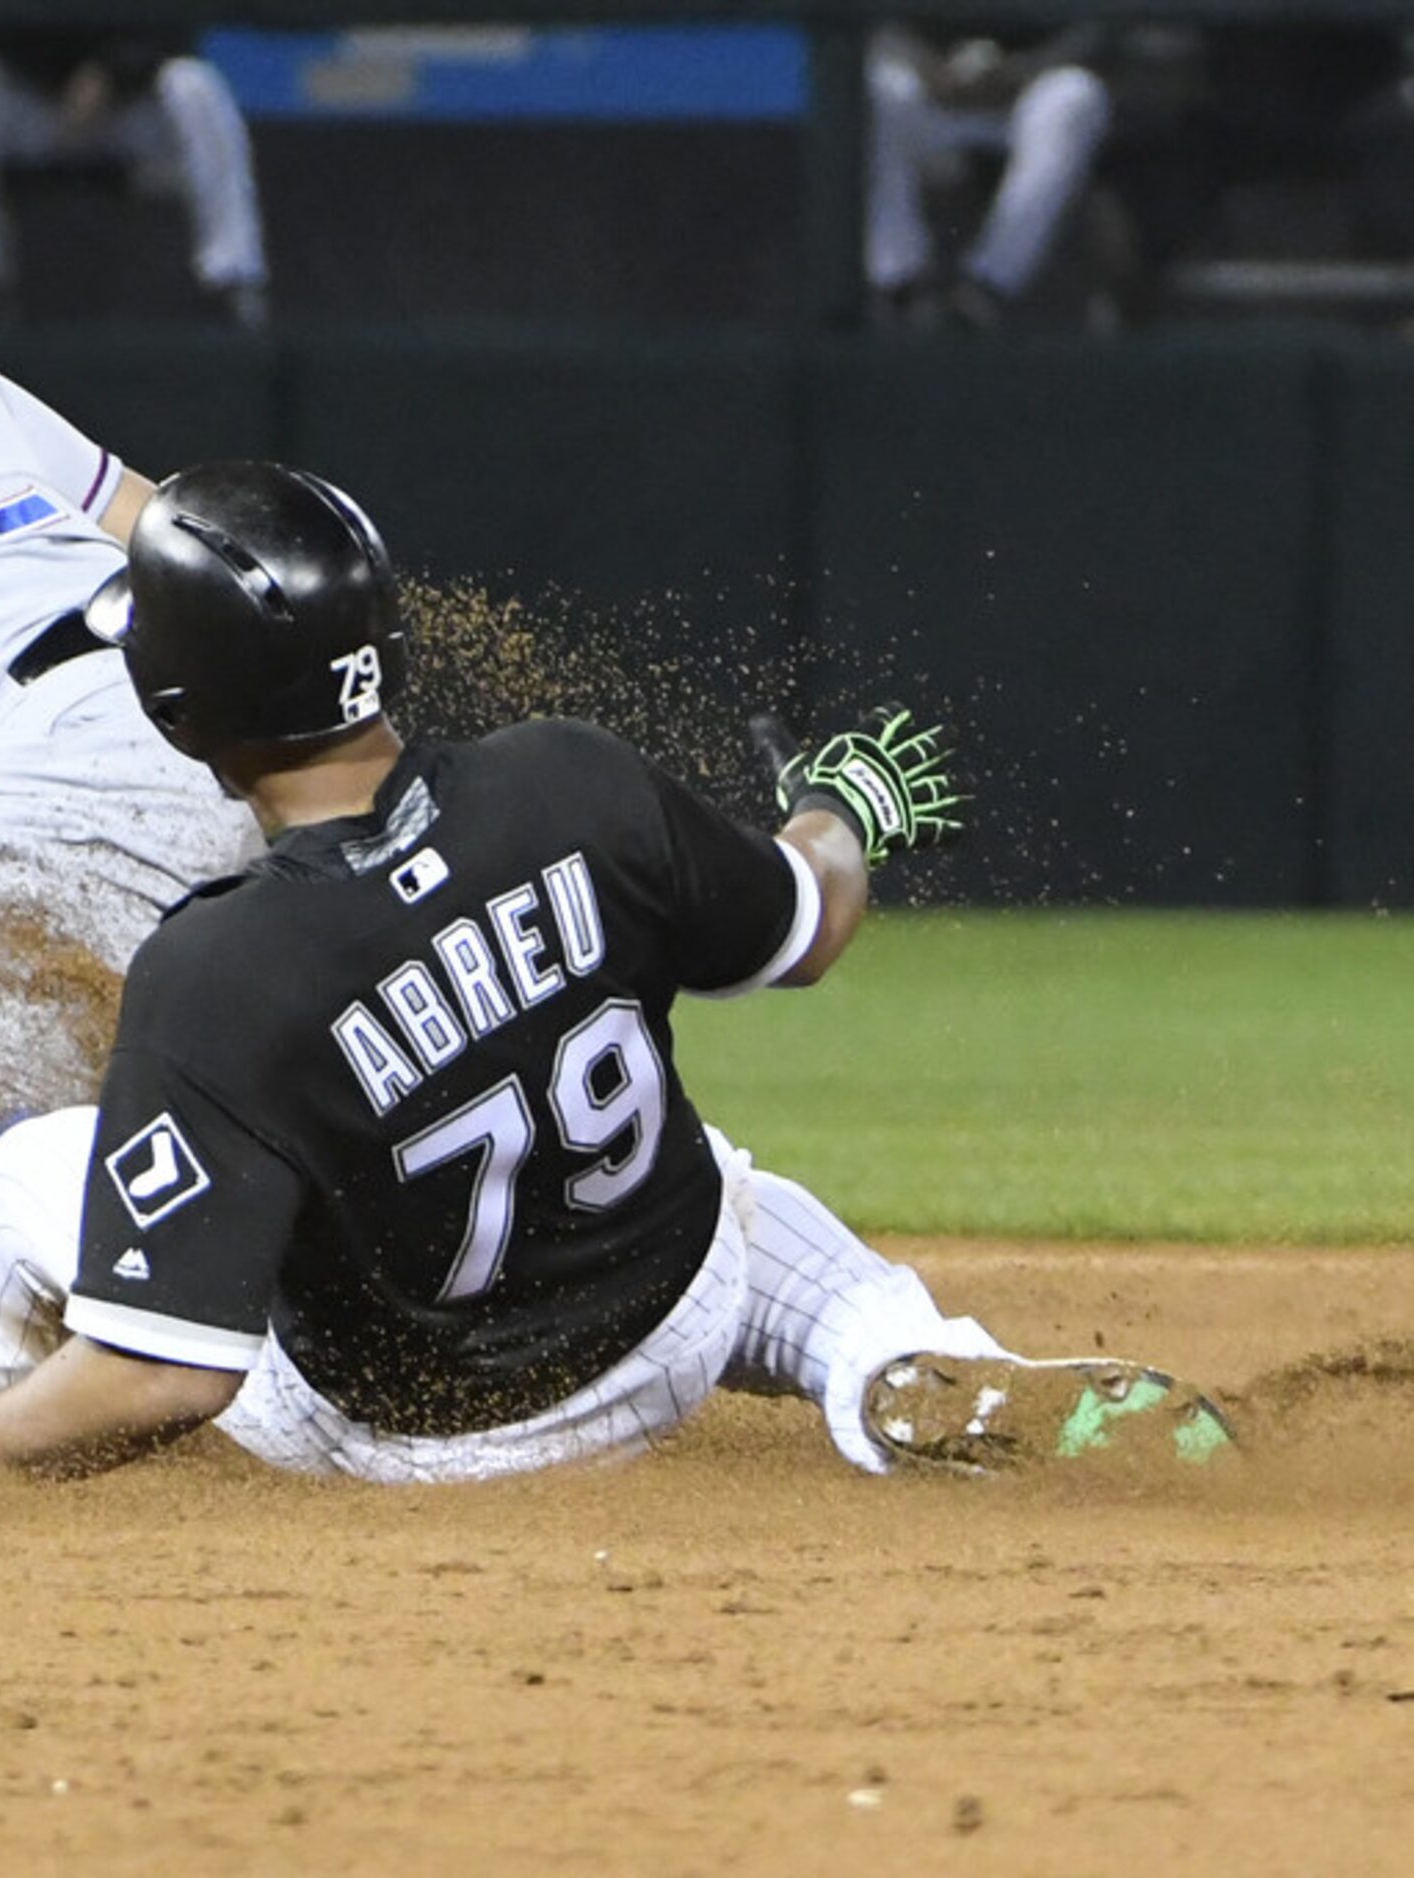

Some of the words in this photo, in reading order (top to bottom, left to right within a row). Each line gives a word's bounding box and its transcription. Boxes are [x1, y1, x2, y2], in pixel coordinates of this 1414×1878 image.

[330, 644, 382, 704] 79
[330, 851, 606, 1117] ABREU
[391, 998, 667, 1302] 79
